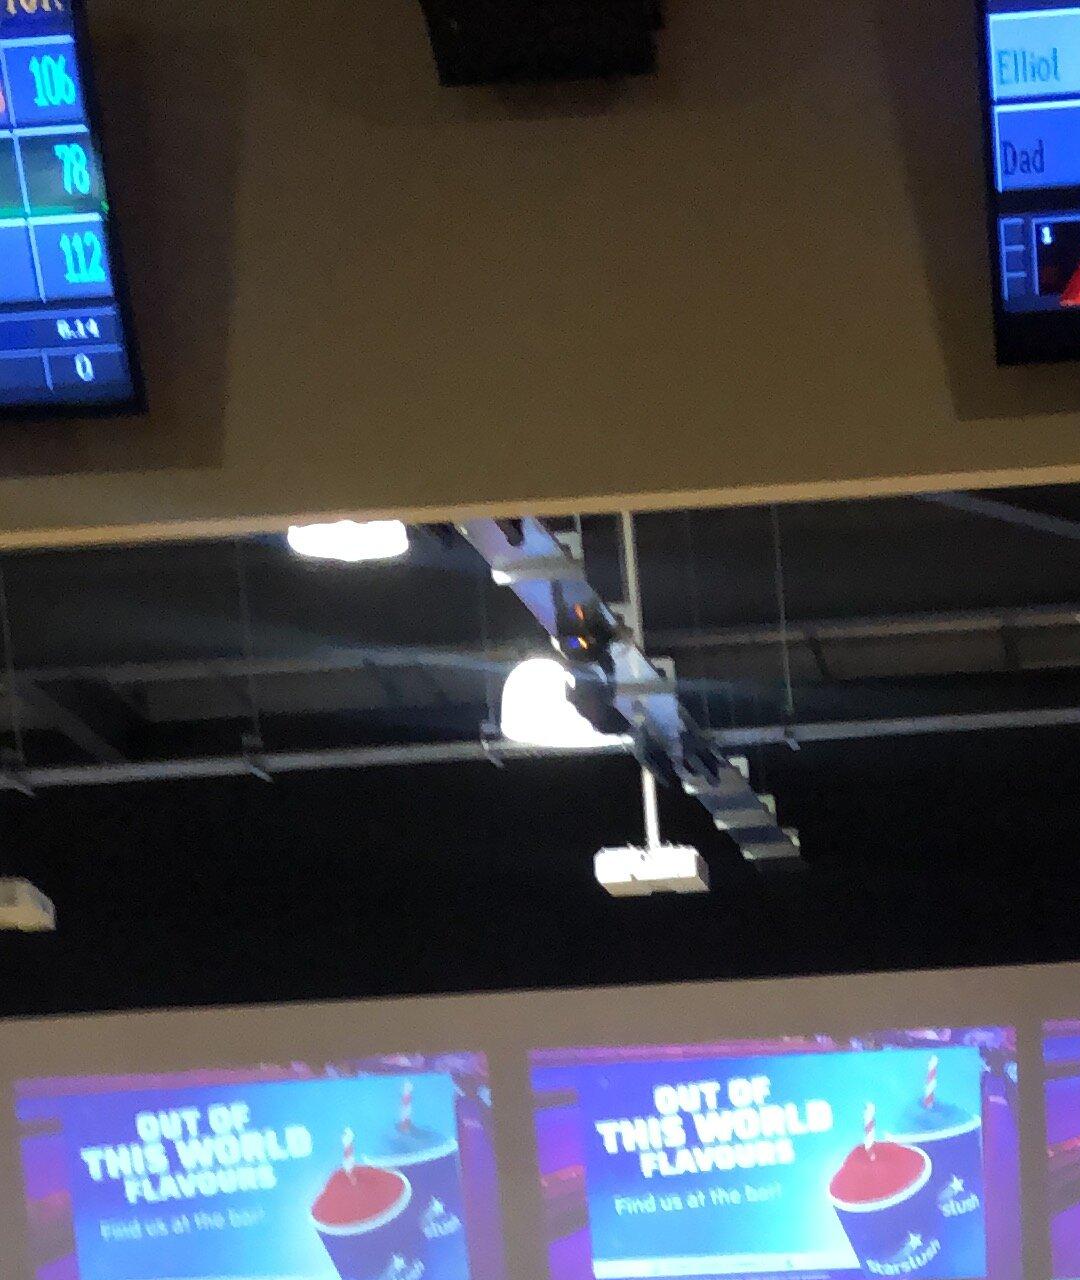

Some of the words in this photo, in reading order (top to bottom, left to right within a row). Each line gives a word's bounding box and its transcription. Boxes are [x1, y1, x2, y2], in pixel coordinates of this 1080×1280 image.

[29, 53, 76, 107] 106
[998, 47, 1061, 85] Elliot
[54, 144, 91, 195] 78
[1001, 139, 1045, 176] Dad
[59, 231, 106, 283] 112
[74, 353, 94, 381] 0
[653, 1080, 720, 1114] OUT
[728, 1075, 770, 1107] OF
[136, 1106, 200, 1143] OUT
[208, 1101, 249, 1135] OF
[595, 1114, 686, 1154] THIS
[692, 1098, 833, 1143] WORLD
[80, 1142, 169, 1181] THIS
[175, 1125, 313, 1169] WORLD
[640, 1137, 795, 1178] FLAVOURS
[123, 1164, 277, 1204] FLAVOURS
[615, 1193, 657, 1216] Find
[660, 1195, 683, 1211] us
[687, 1190, 705, 1208] at
[709, 1186, 741, 1205] the
